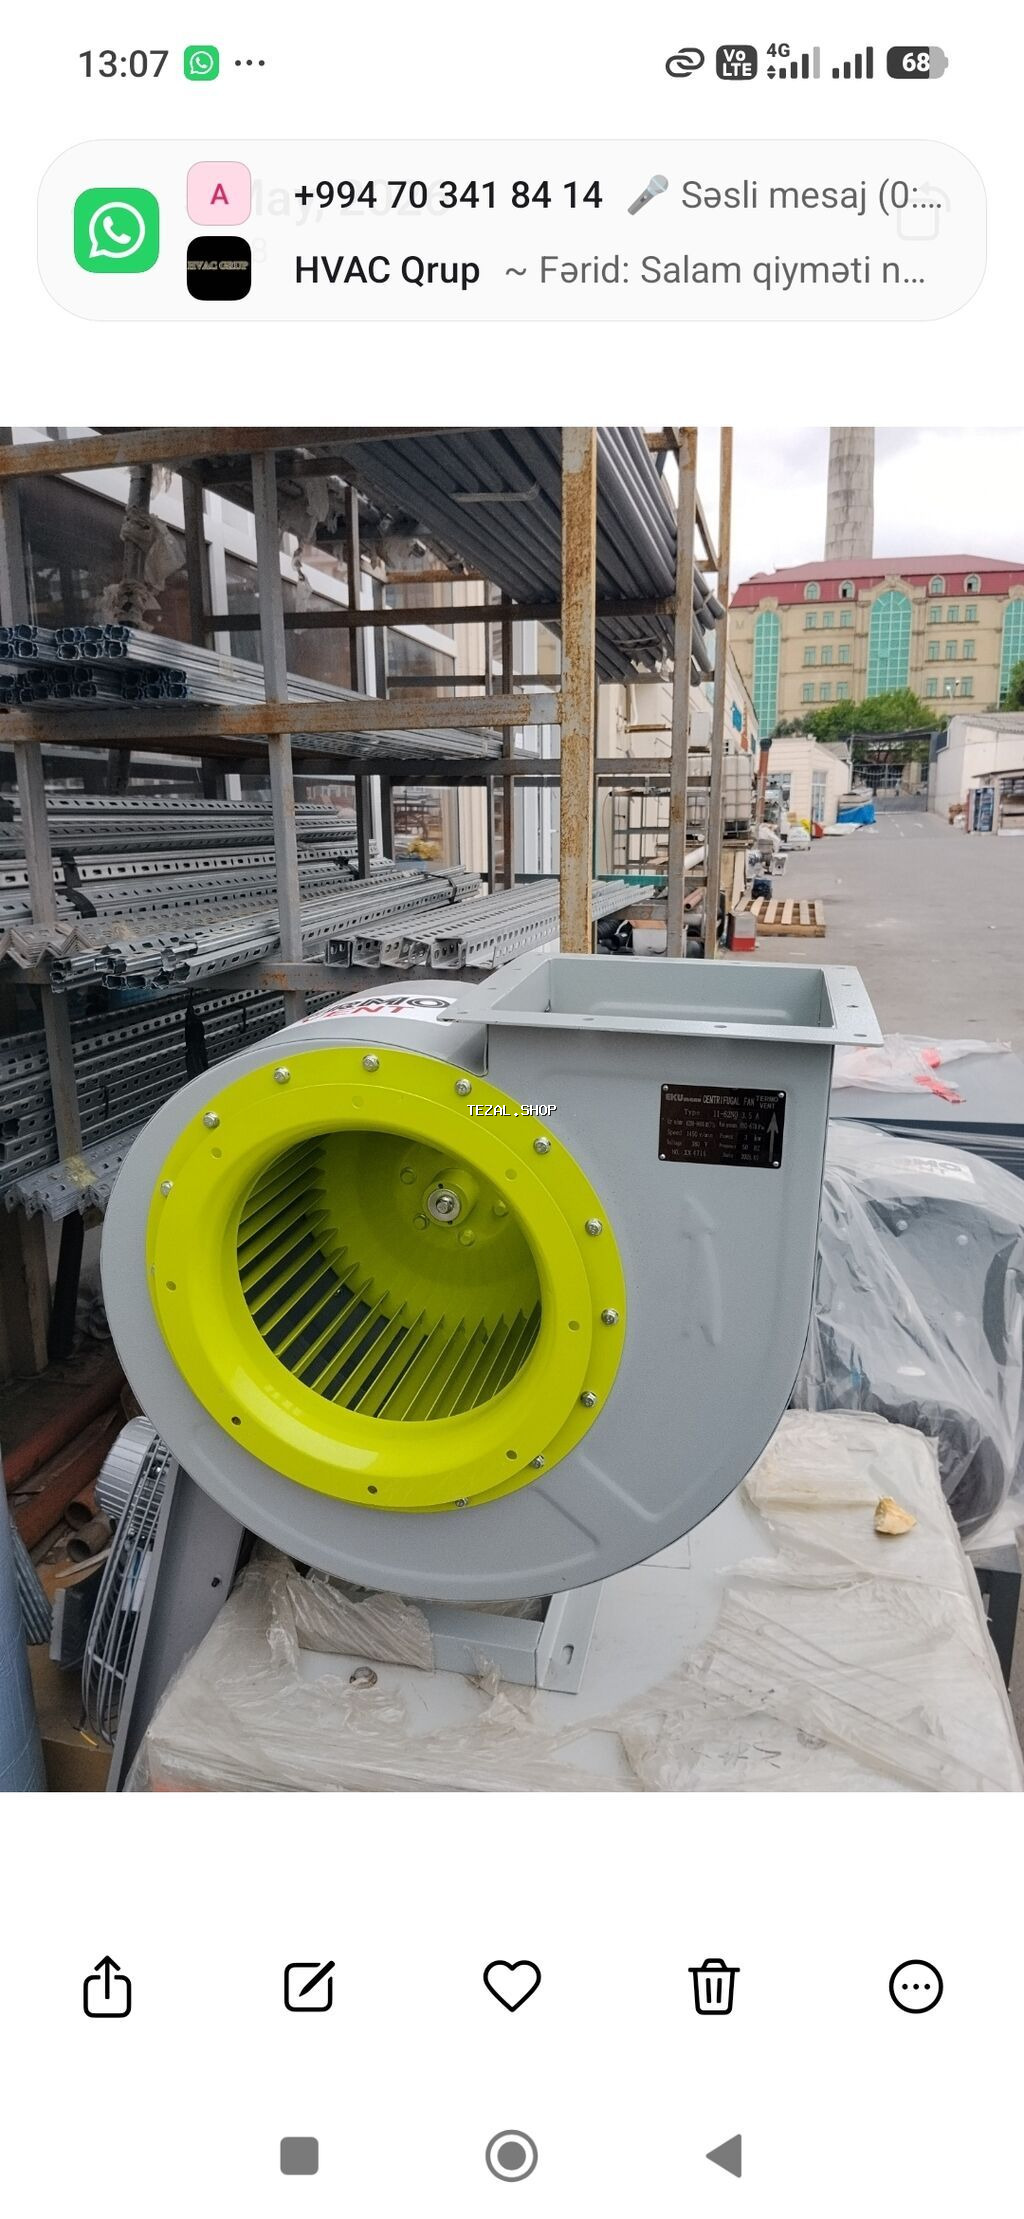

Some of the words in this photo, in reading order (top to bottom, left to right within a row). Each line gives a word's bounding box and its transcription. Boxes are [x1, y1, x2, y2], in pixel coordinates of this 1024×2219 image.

[723, 49, 746, 62] Vo
[766, 43, 790, 57] 4G
[79, 50, 169, 78] 13:07
[902, 52, 930, 72] 68
[722, 63, 752, 77] LTE
[209, 183, 229, 205] A
[294, 181, 377, 209] +994
[388, 181, 428, 209] 70
[439, 181, 495, 209] 341
[511, 181, 552, 209] 84
[563, 181, 603, 209] 14
[682, 180, 757, 209] Səsli
[770, 181, 866, 216] mesaj
[187, 260, 218, 270] HVAC
[296, 256, 391, 284] HVAC
[401, 256, 480, 291] Qrup
[541, 255, 629, 284] Fərid:
[641, 255, 741, 284] Salam
[753, 256, 870, 291] qiyməti
[703, 1095, 741, 1106] CENTRIFUGAL
[744, 1098, 755, 1107] FAN
[756, 1095, 779, 1103] TERMO
